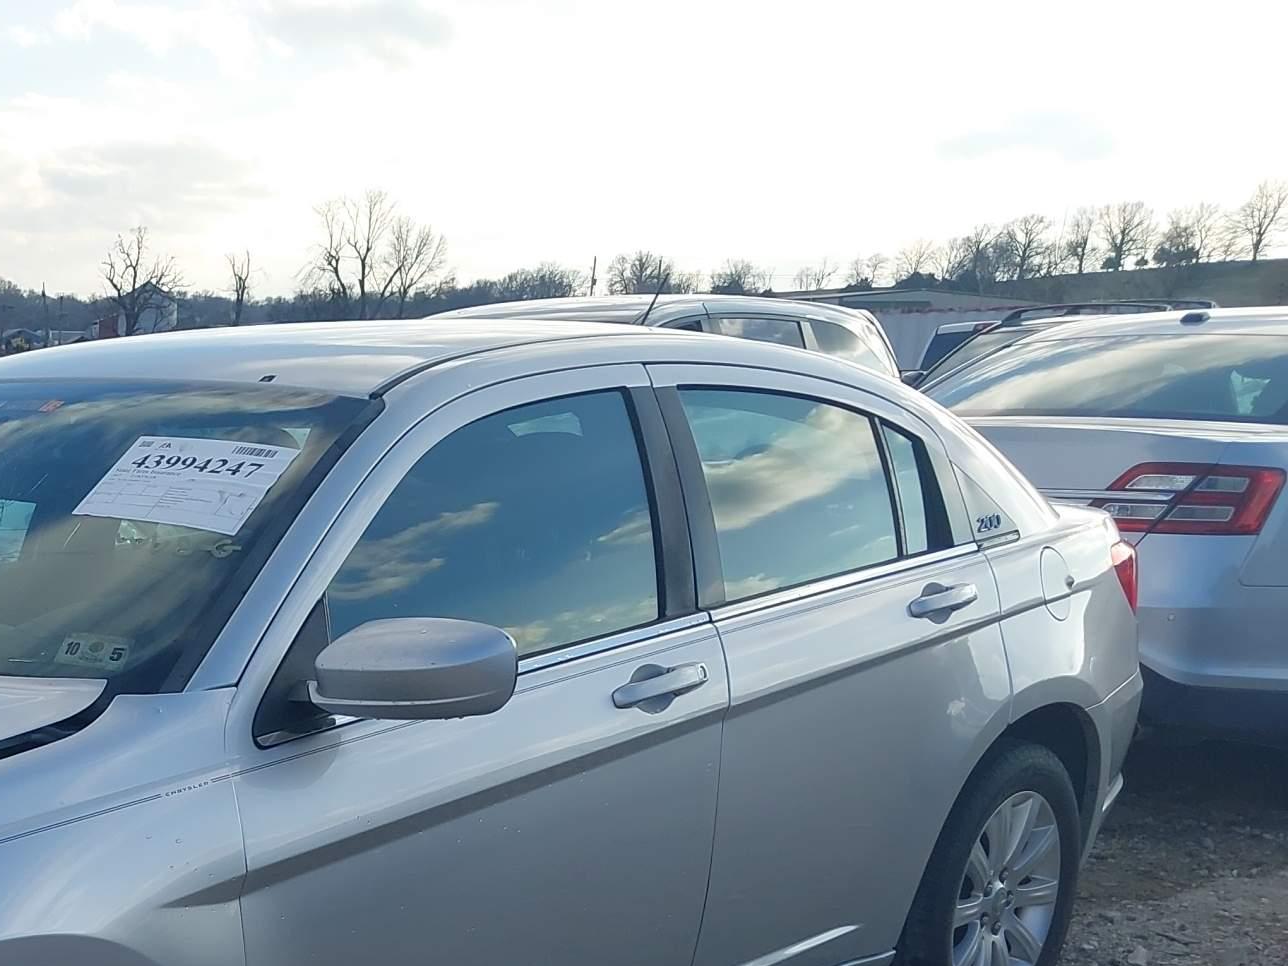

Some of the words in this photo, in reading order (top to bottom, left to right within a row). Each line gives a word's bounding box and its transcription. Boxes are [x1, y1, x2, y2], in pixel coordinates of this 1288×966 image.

[131, 453, 265, 478] 43994247
[976, 512, 1002, 533] 200
[64, 640, 81, 656] 10
[109, 647, 126, 662] 5
